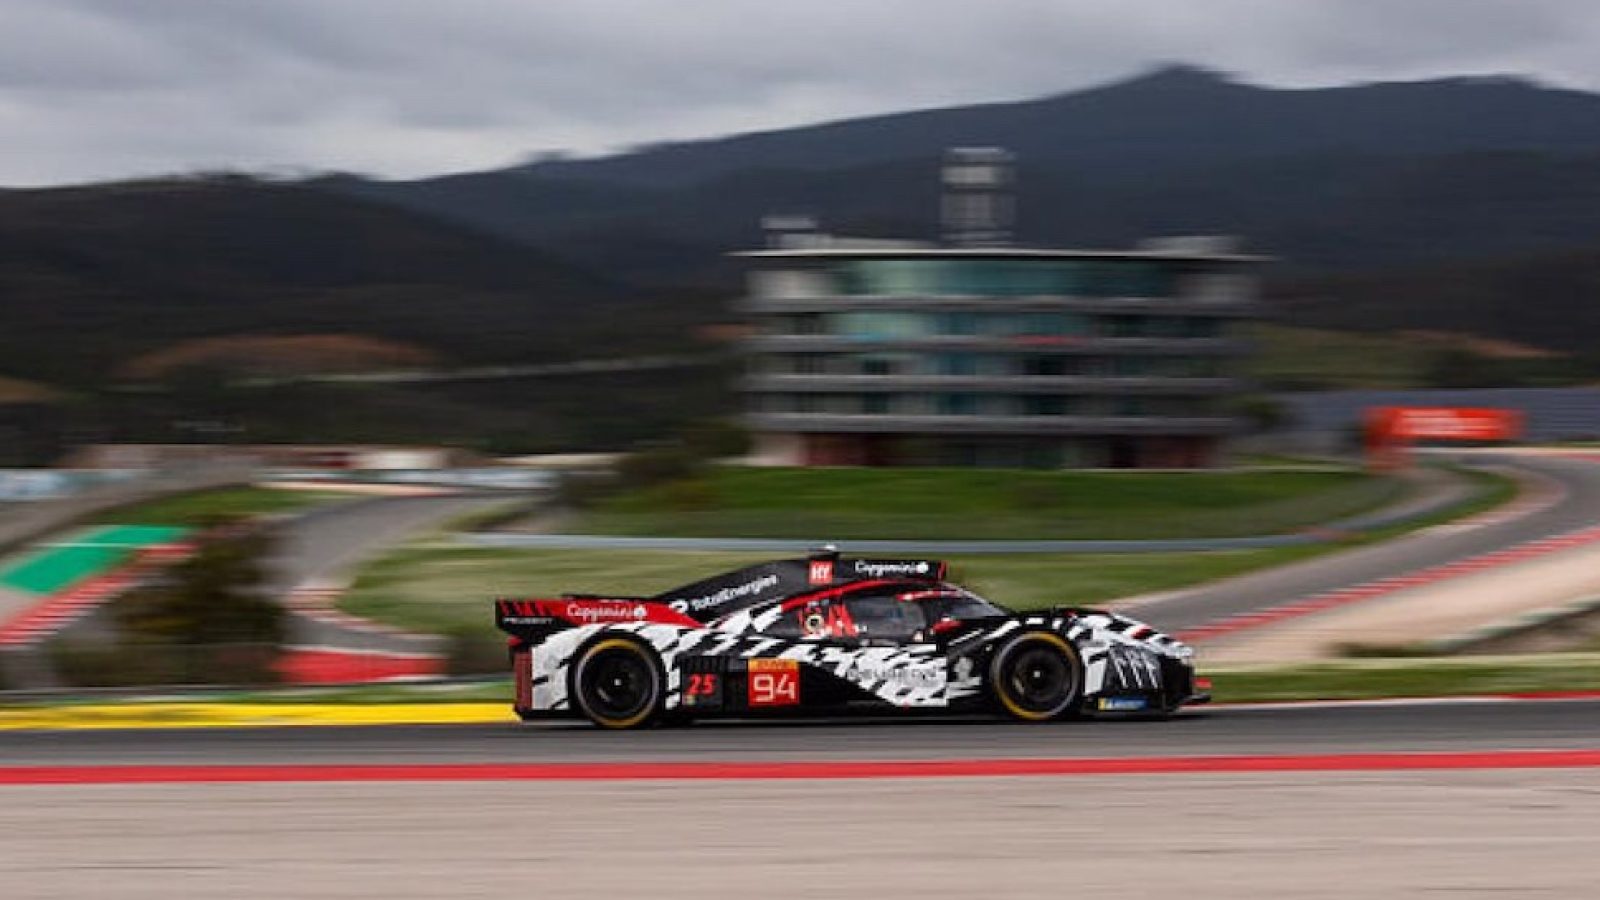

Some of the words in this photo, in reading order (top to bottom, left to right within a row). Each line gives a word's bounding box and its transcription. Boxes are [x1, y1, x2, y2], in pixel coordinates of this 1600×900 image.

[855, 560, 916, 577] Capgemini
[691, 575, 777, 611] TotalEnergies
[566, 603, 634, 622] Capgemini
[687, 673, 716, 695] 25
[753, 673, 796, 703] 94
